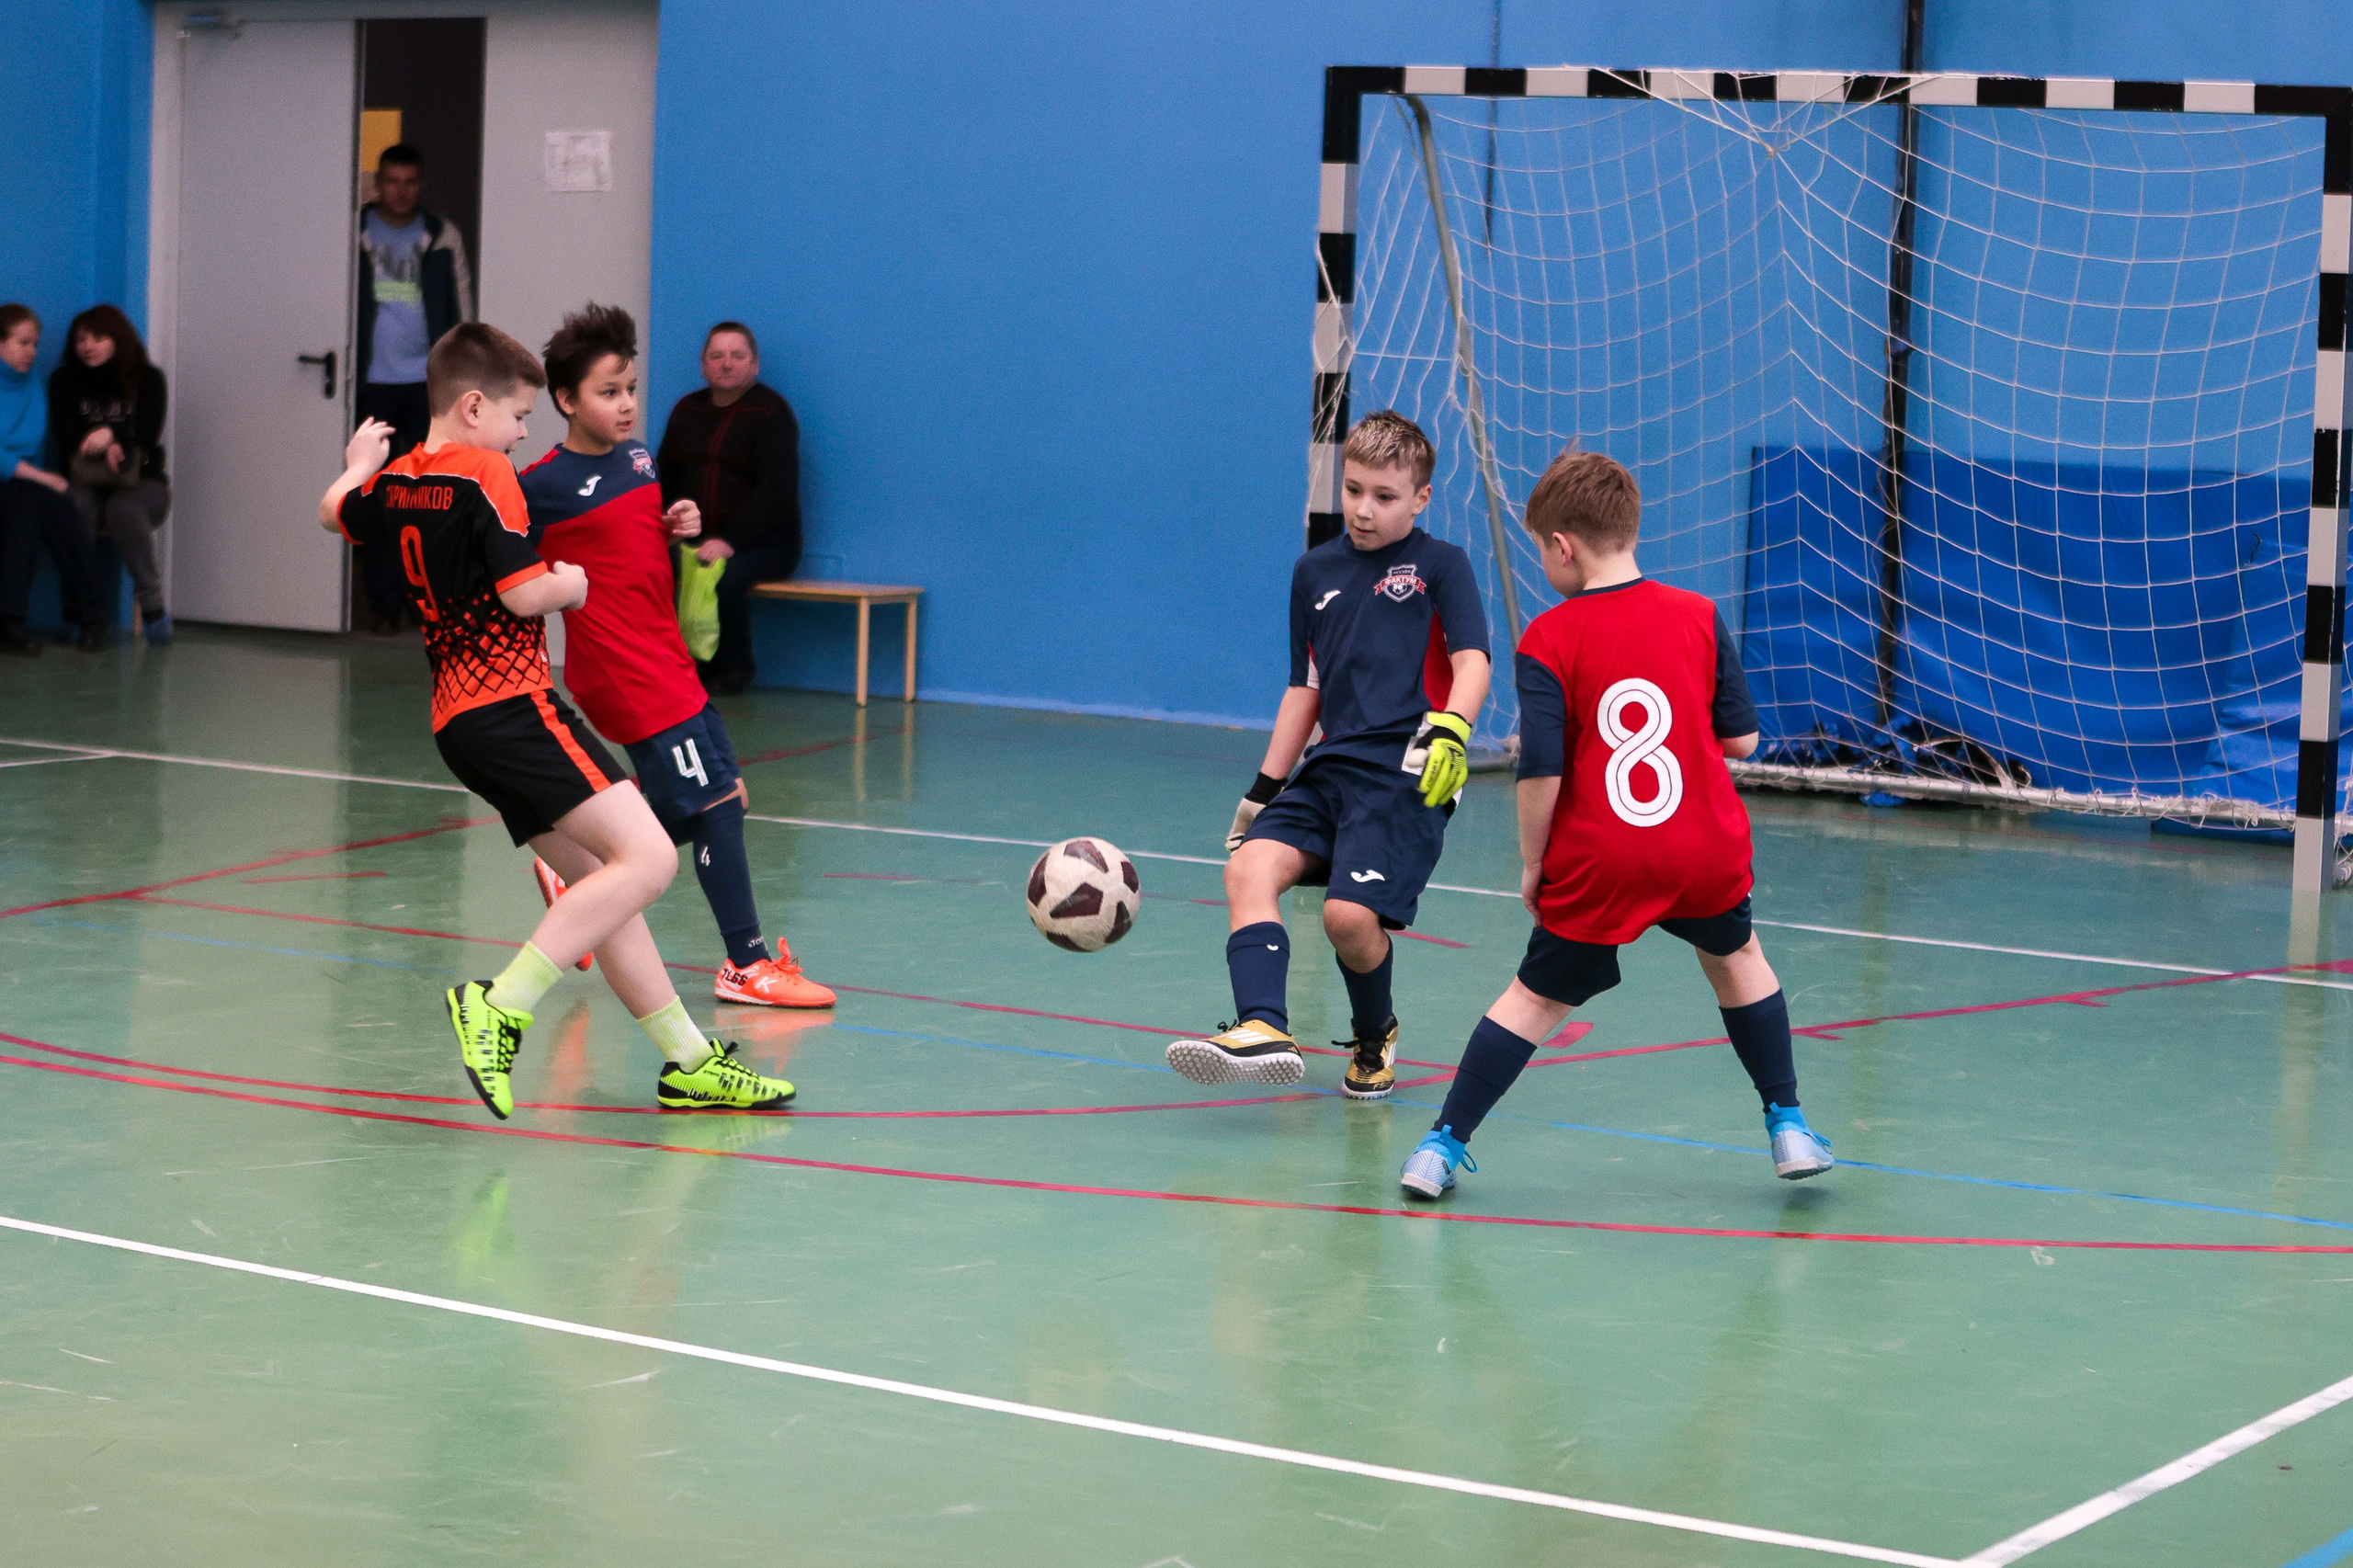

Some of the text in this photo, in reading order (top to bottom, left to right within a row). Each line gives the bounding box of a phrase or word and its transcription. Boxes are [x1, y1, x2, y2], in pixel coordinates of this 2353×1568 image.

[400, 525, 440, 622] 9
[1384, 576, 1417, 585] ФАКТУМ
[672, 738, 710, 788] 4
[1597, 676, 1684, 827] 8
[700, 846, 711, 867] 4
